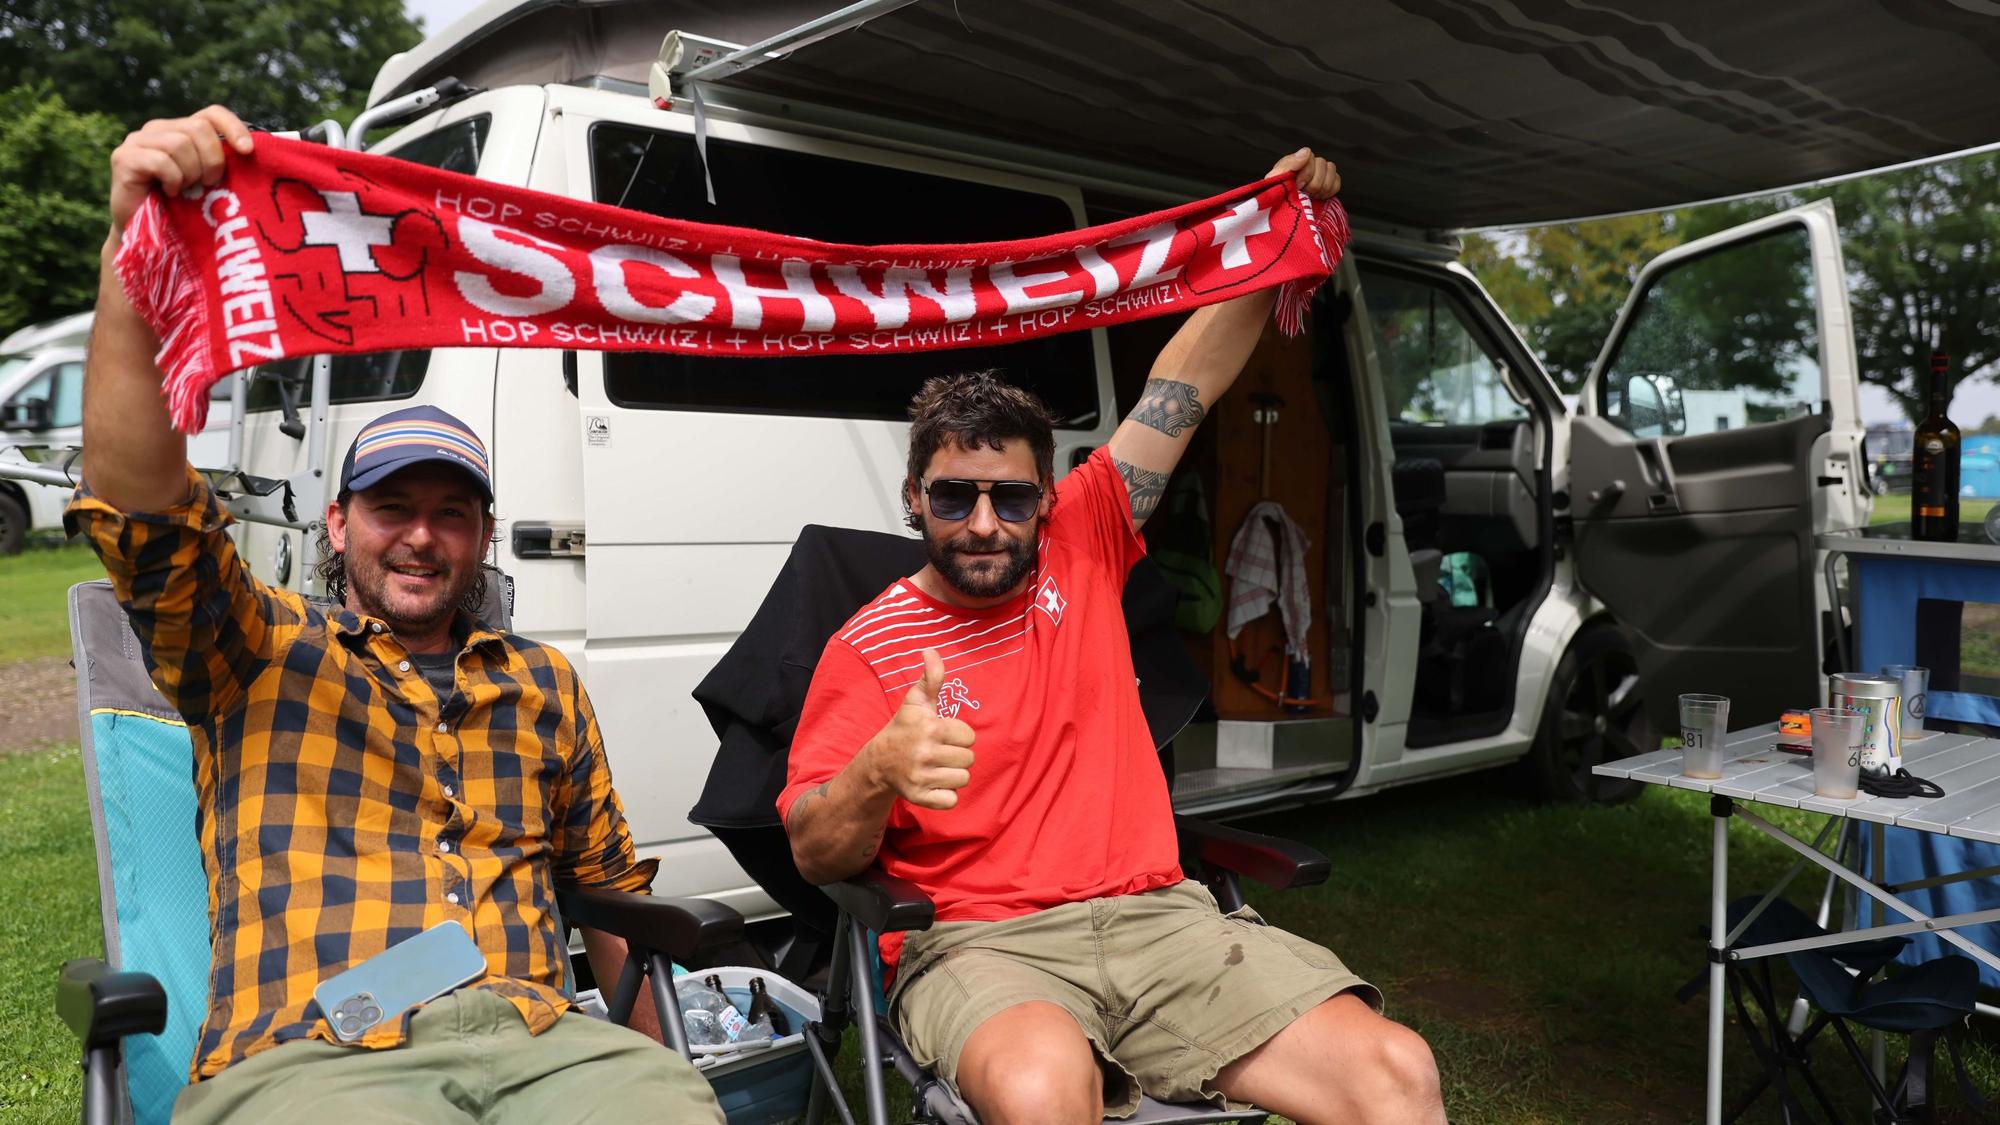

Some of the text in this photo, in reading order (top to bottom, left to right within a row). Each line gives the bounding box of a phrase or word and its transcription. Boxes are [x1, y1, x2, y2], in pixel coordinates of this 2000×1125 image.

[435, 189, 522, 221] HOP
[184, 186, 284, 368] CHWEIZ
[454, 215, 1185, 331] SCHWEIZ
[461, 317, 538, 343] HOP
[550, 322, 713, 350] SCHWIIZ!
[763, 333, 835, 351] HOP
[850, 321, 982, 350] SCHWIIZ!
[1020, 305, 1076, 334] HOP
[1084, 283, 1184, 318] SCHWIIZ!
